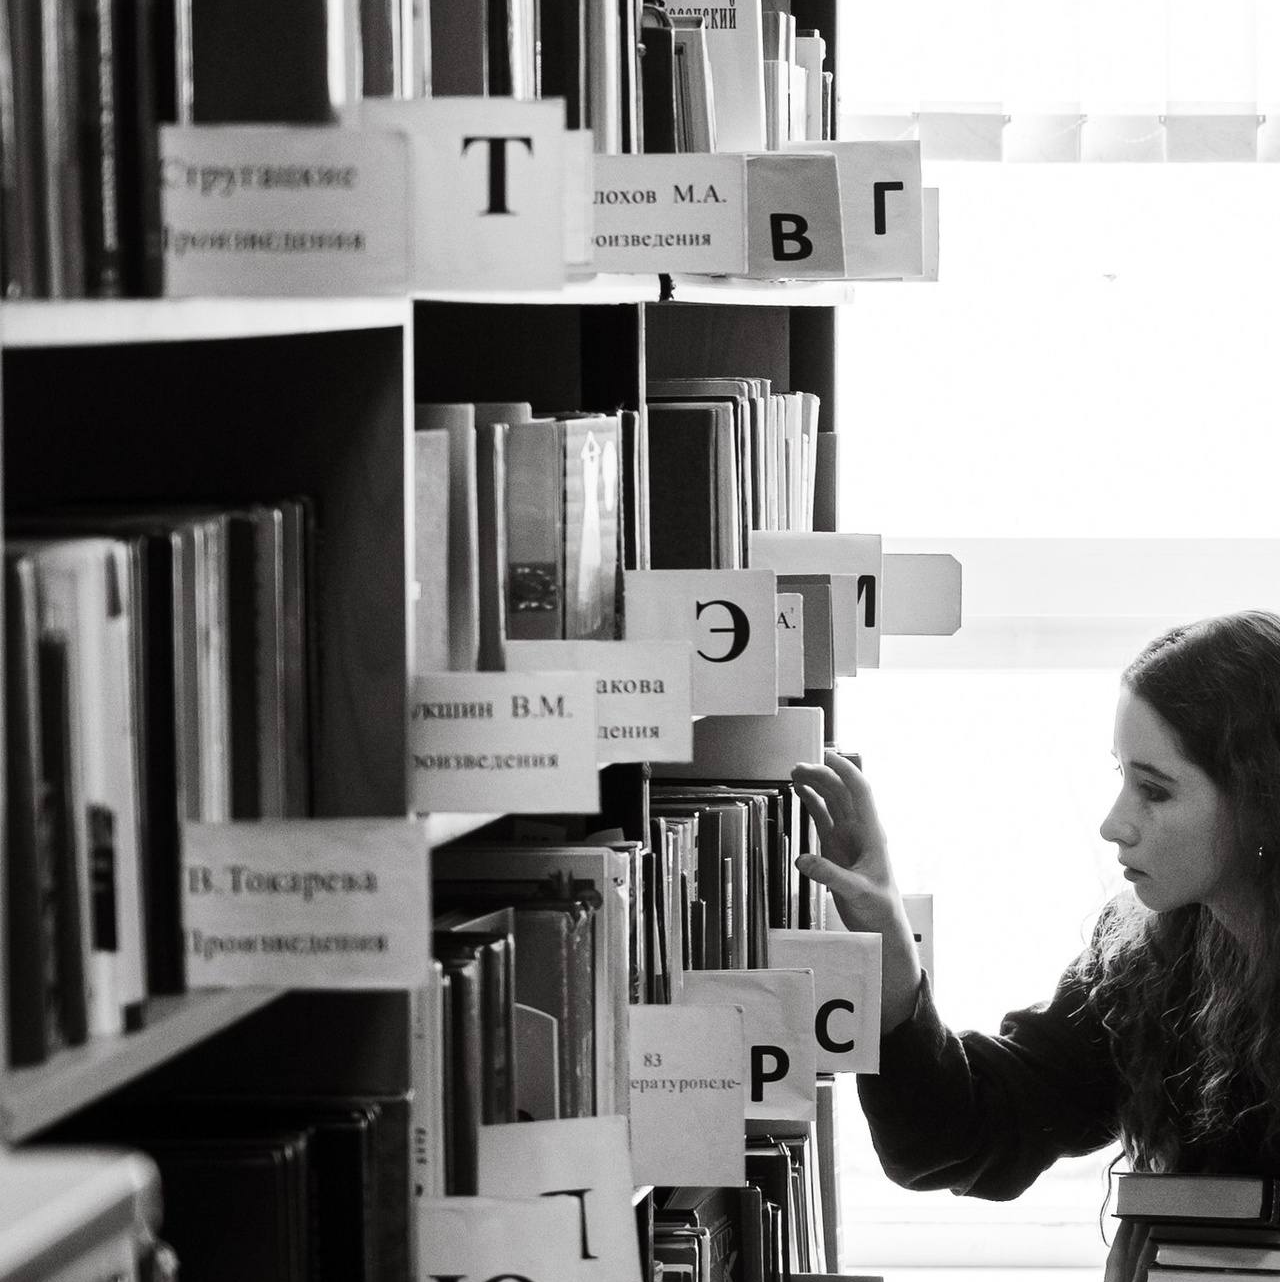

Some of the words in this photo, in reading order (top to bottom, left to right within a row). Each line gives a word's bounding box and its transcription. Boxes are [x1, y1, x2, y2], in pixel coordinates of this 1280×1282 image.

[461, 135, 534, 216] Т
[672, 183, 727, 205] М.А.
[873, 181, 904, 235] Г
[591, 231, 713, 248] оизведения
[769, 212, 813, 262] В
[695, 599, 751, 663] Э
[814, 998, 855, 1054] С
[643, 1052, 662, 1068] 83
[750, 1044, 790, 1103] Р
